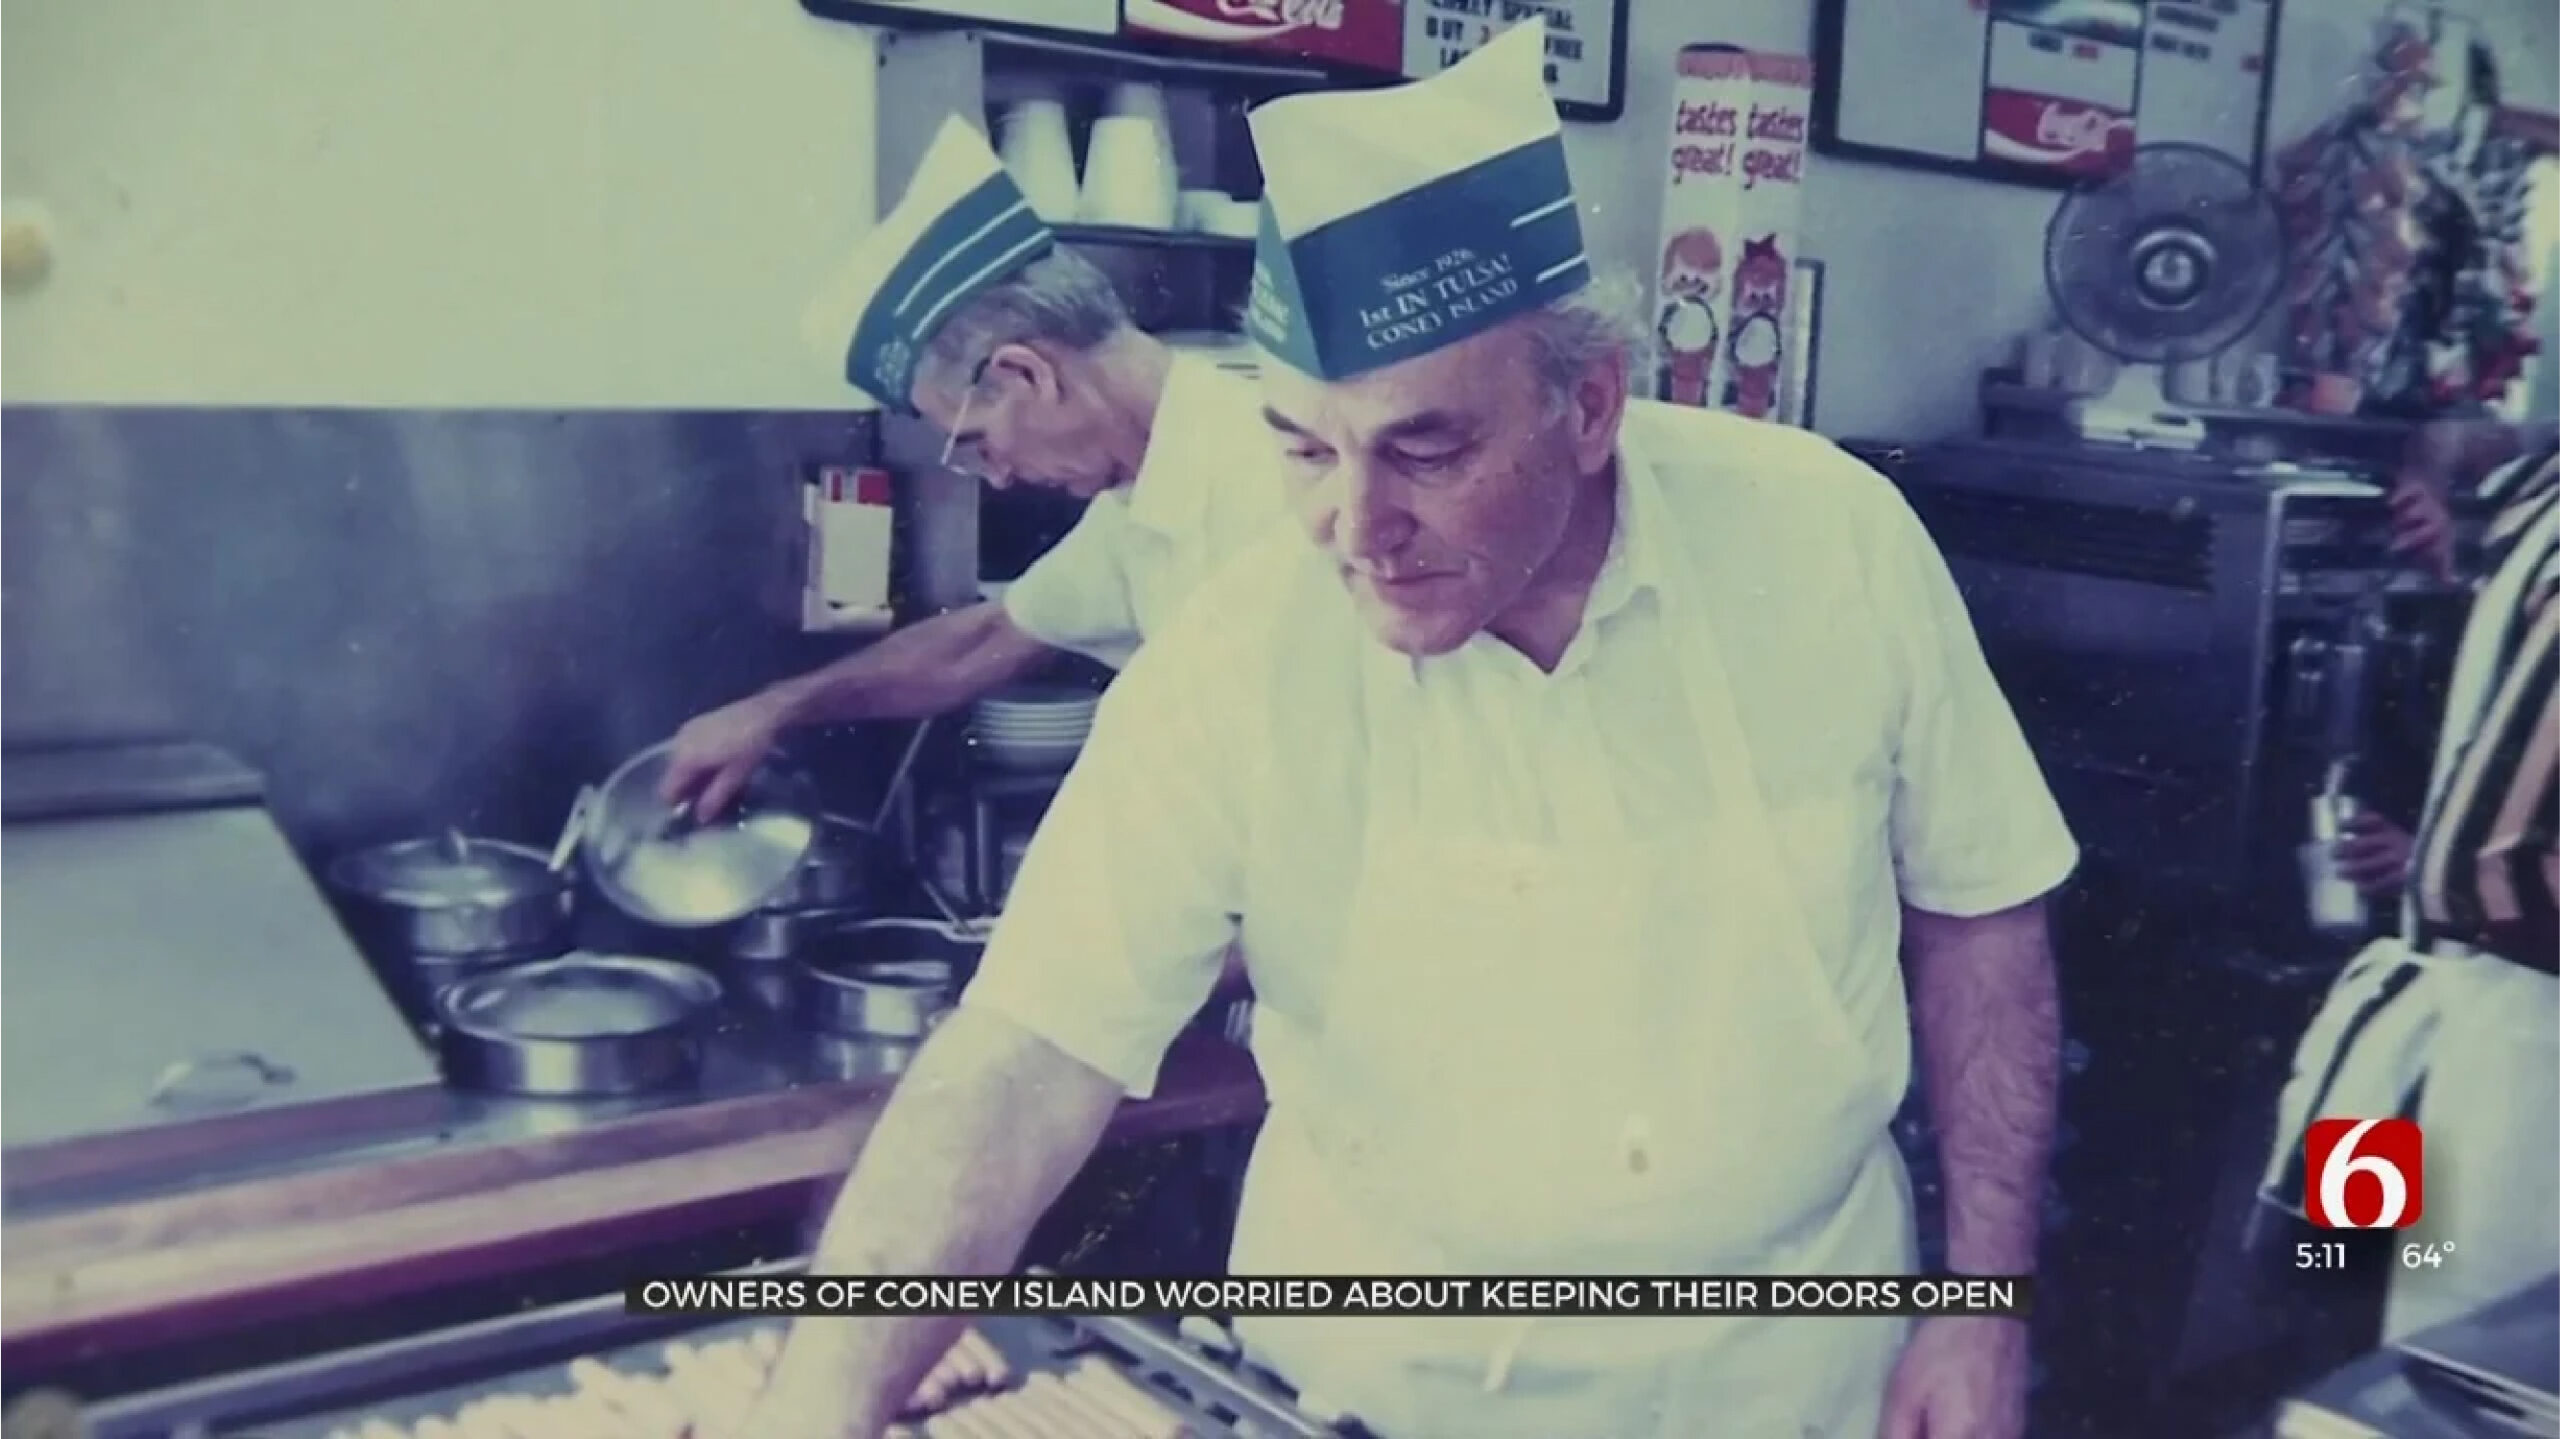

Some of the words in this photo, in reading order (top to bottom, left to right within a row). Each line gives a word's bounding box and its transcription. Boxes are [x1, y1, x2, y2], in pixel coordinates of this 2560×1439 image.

[1676, 99, 1738, 135] tastes
[1747, 102, 1804, 143] tastes
[1672, 142, 1735, 185] great!
[1743, 148, 1800, 190] great!
[1360, 306, 1392, 328] 1st
[1396, 288, 1429, 315] IN
[1367, 312, 1443, 349] CONEY
[1449, 278, 1518, 320] ISLAND
